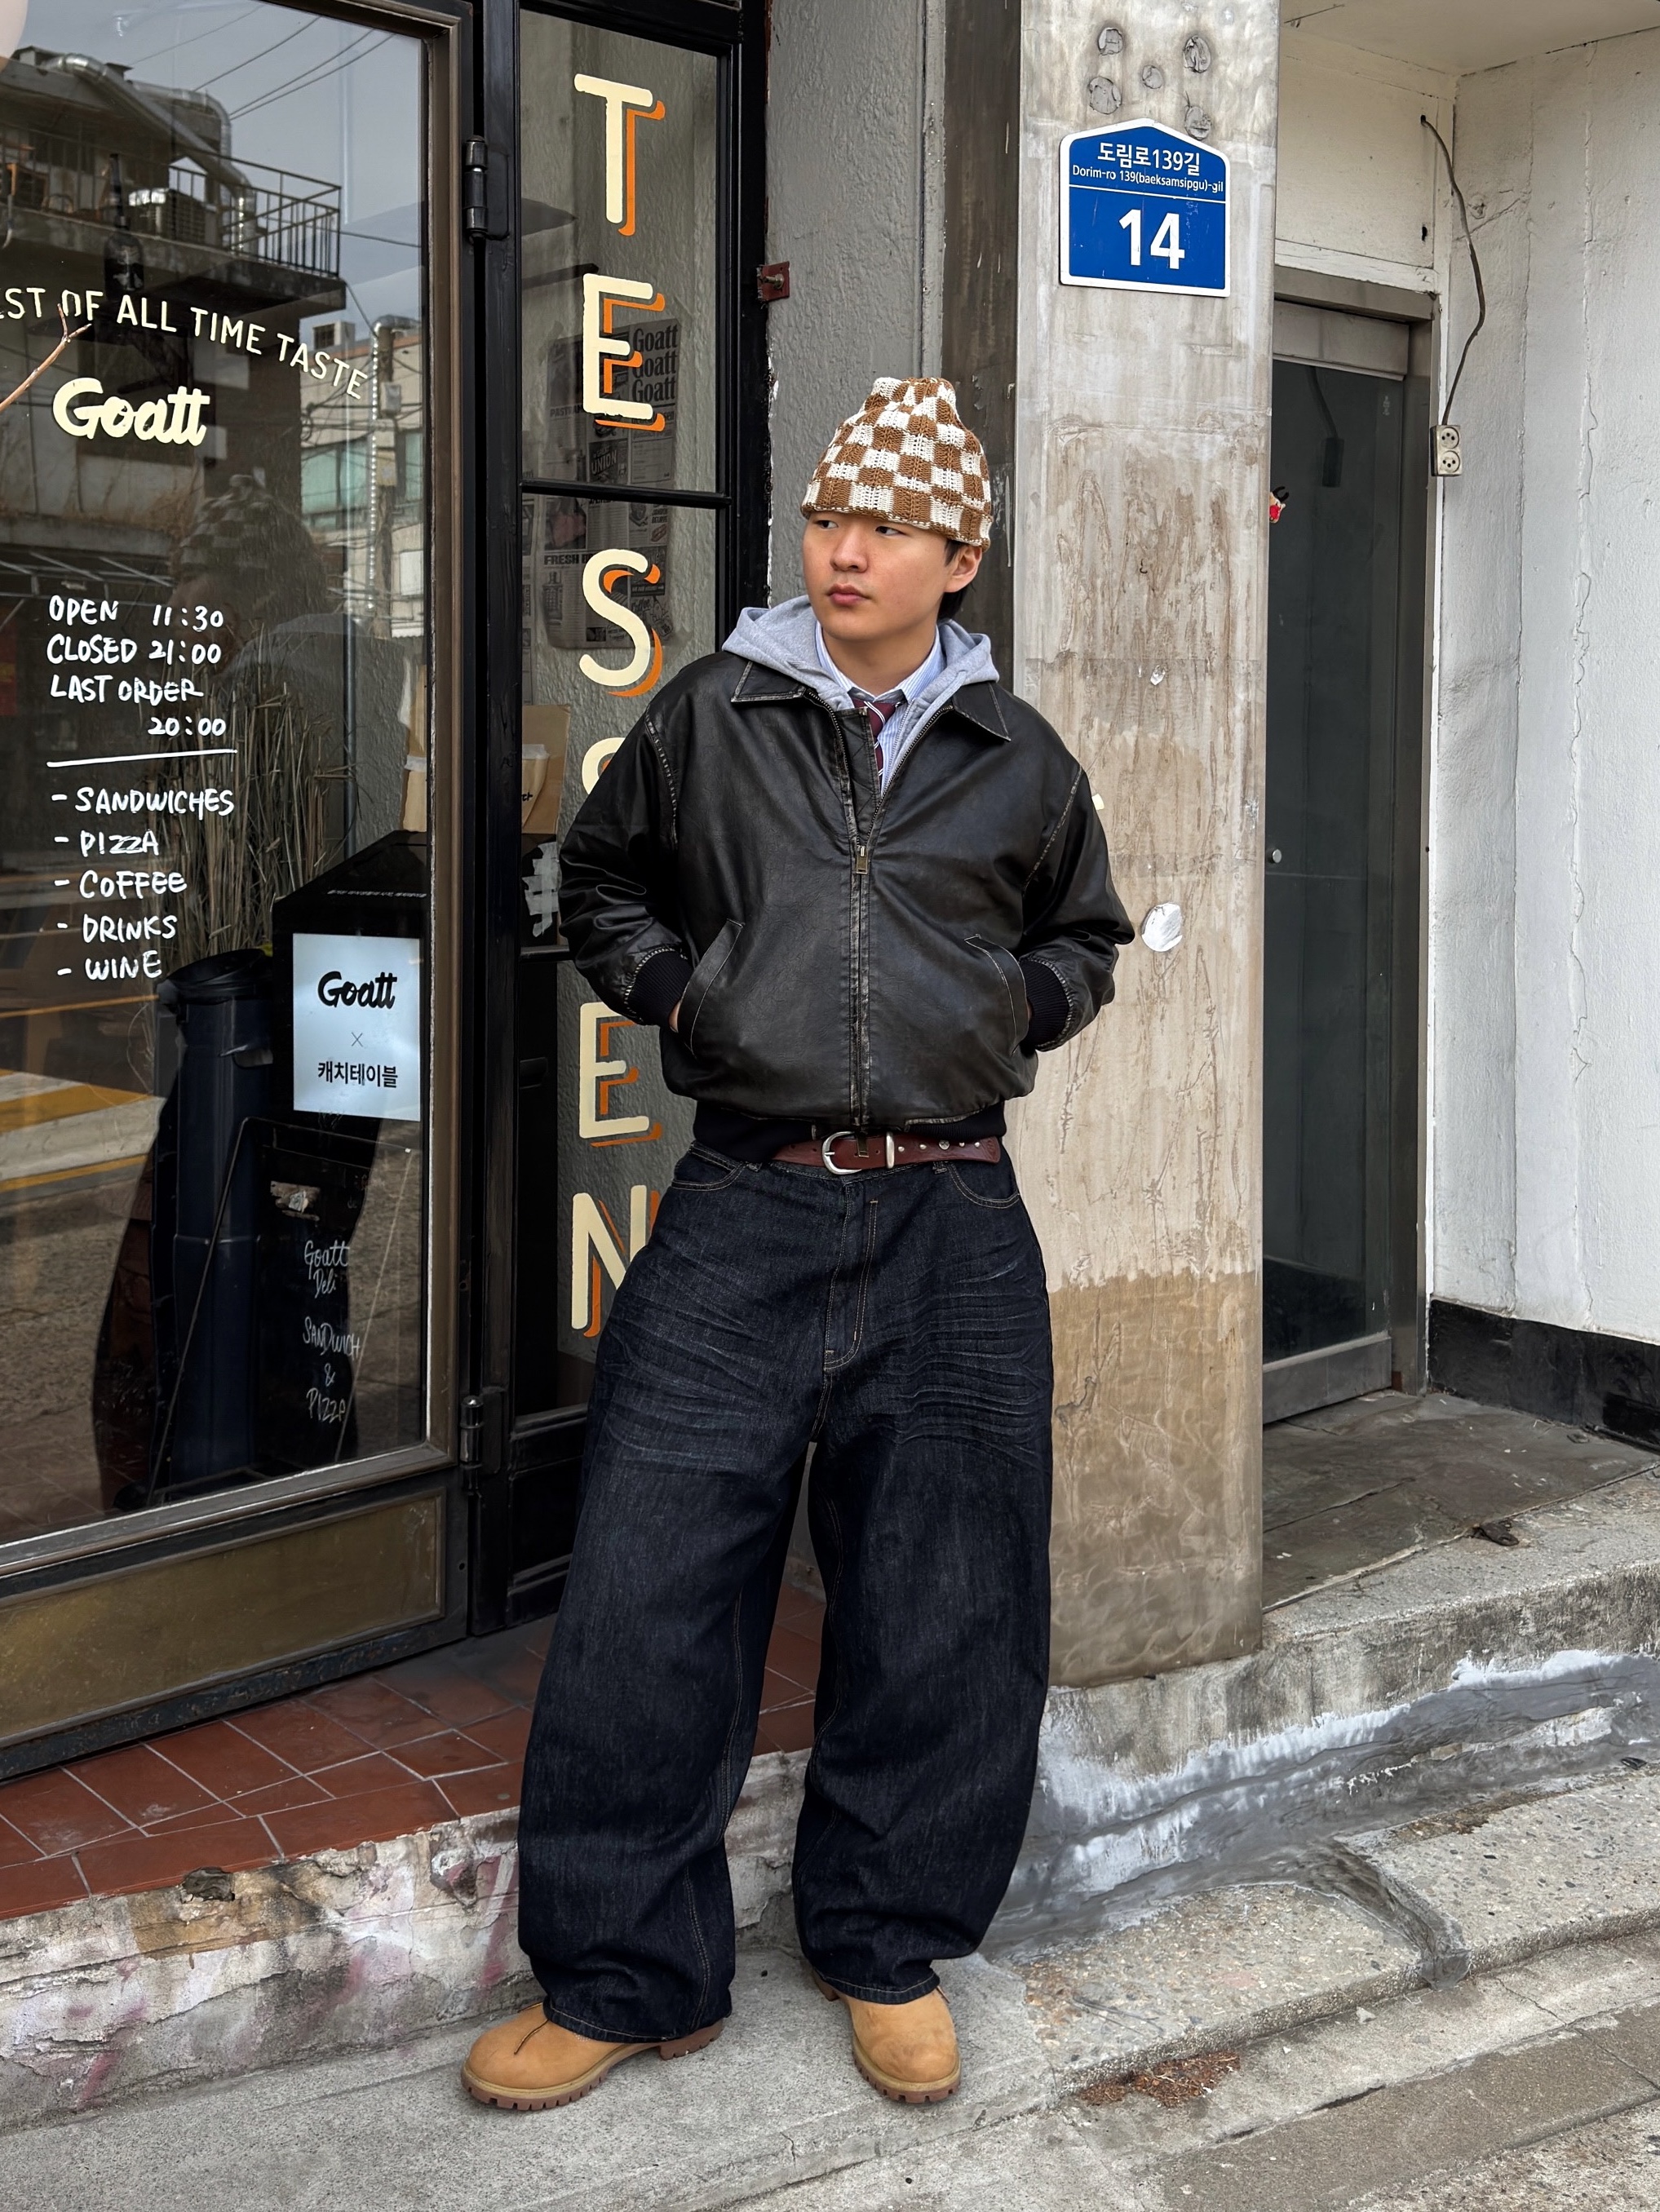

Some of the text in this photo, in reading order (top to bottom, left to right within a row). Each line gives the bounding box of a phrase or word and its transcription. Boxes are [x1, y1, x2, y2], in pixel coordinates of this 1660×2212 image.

[1097, 142, 1200, 176] 도림로139길
[1073, 165, 1224, 193] Dorim-ro 139(baeksamsipgu)-gil
[1118, 209, 1185, 270] 14
[0, 287, 369, 400] ST OF ALL TIME TASTE
[632, 324, 678, 352] Goatt
[631, 376, 676, 404] Goatt
[52, 377, 210, 446] Goatt
[591, 449, 618, 475] UNION
[543, 554, 579, 565] FRESH
[49, 595, 224, 632] OPEN 11:30
[46, 633, 222, 665] CLOSED 21:00
[50, 674, 204, 706] LAST ORDER
[573, 73, 663, 1336] TESEN
[148, 716, 227, 737] 20:00
[75, 786, 235, 821] SANDWICHES
[79, 829, 159, 857] PIZZA
[79, 869, 188, 899] COFFEE
[82, 914, 178, 943] DRINKS
[85, 949, 162, 980] WINE
[317, 971, 398, 1010] Goatt
[317, 1060, 398, 1089] 캐치테이블
[303, 1240, 351, 1280] Goatt
[324, 1362, 336, 1387] &
